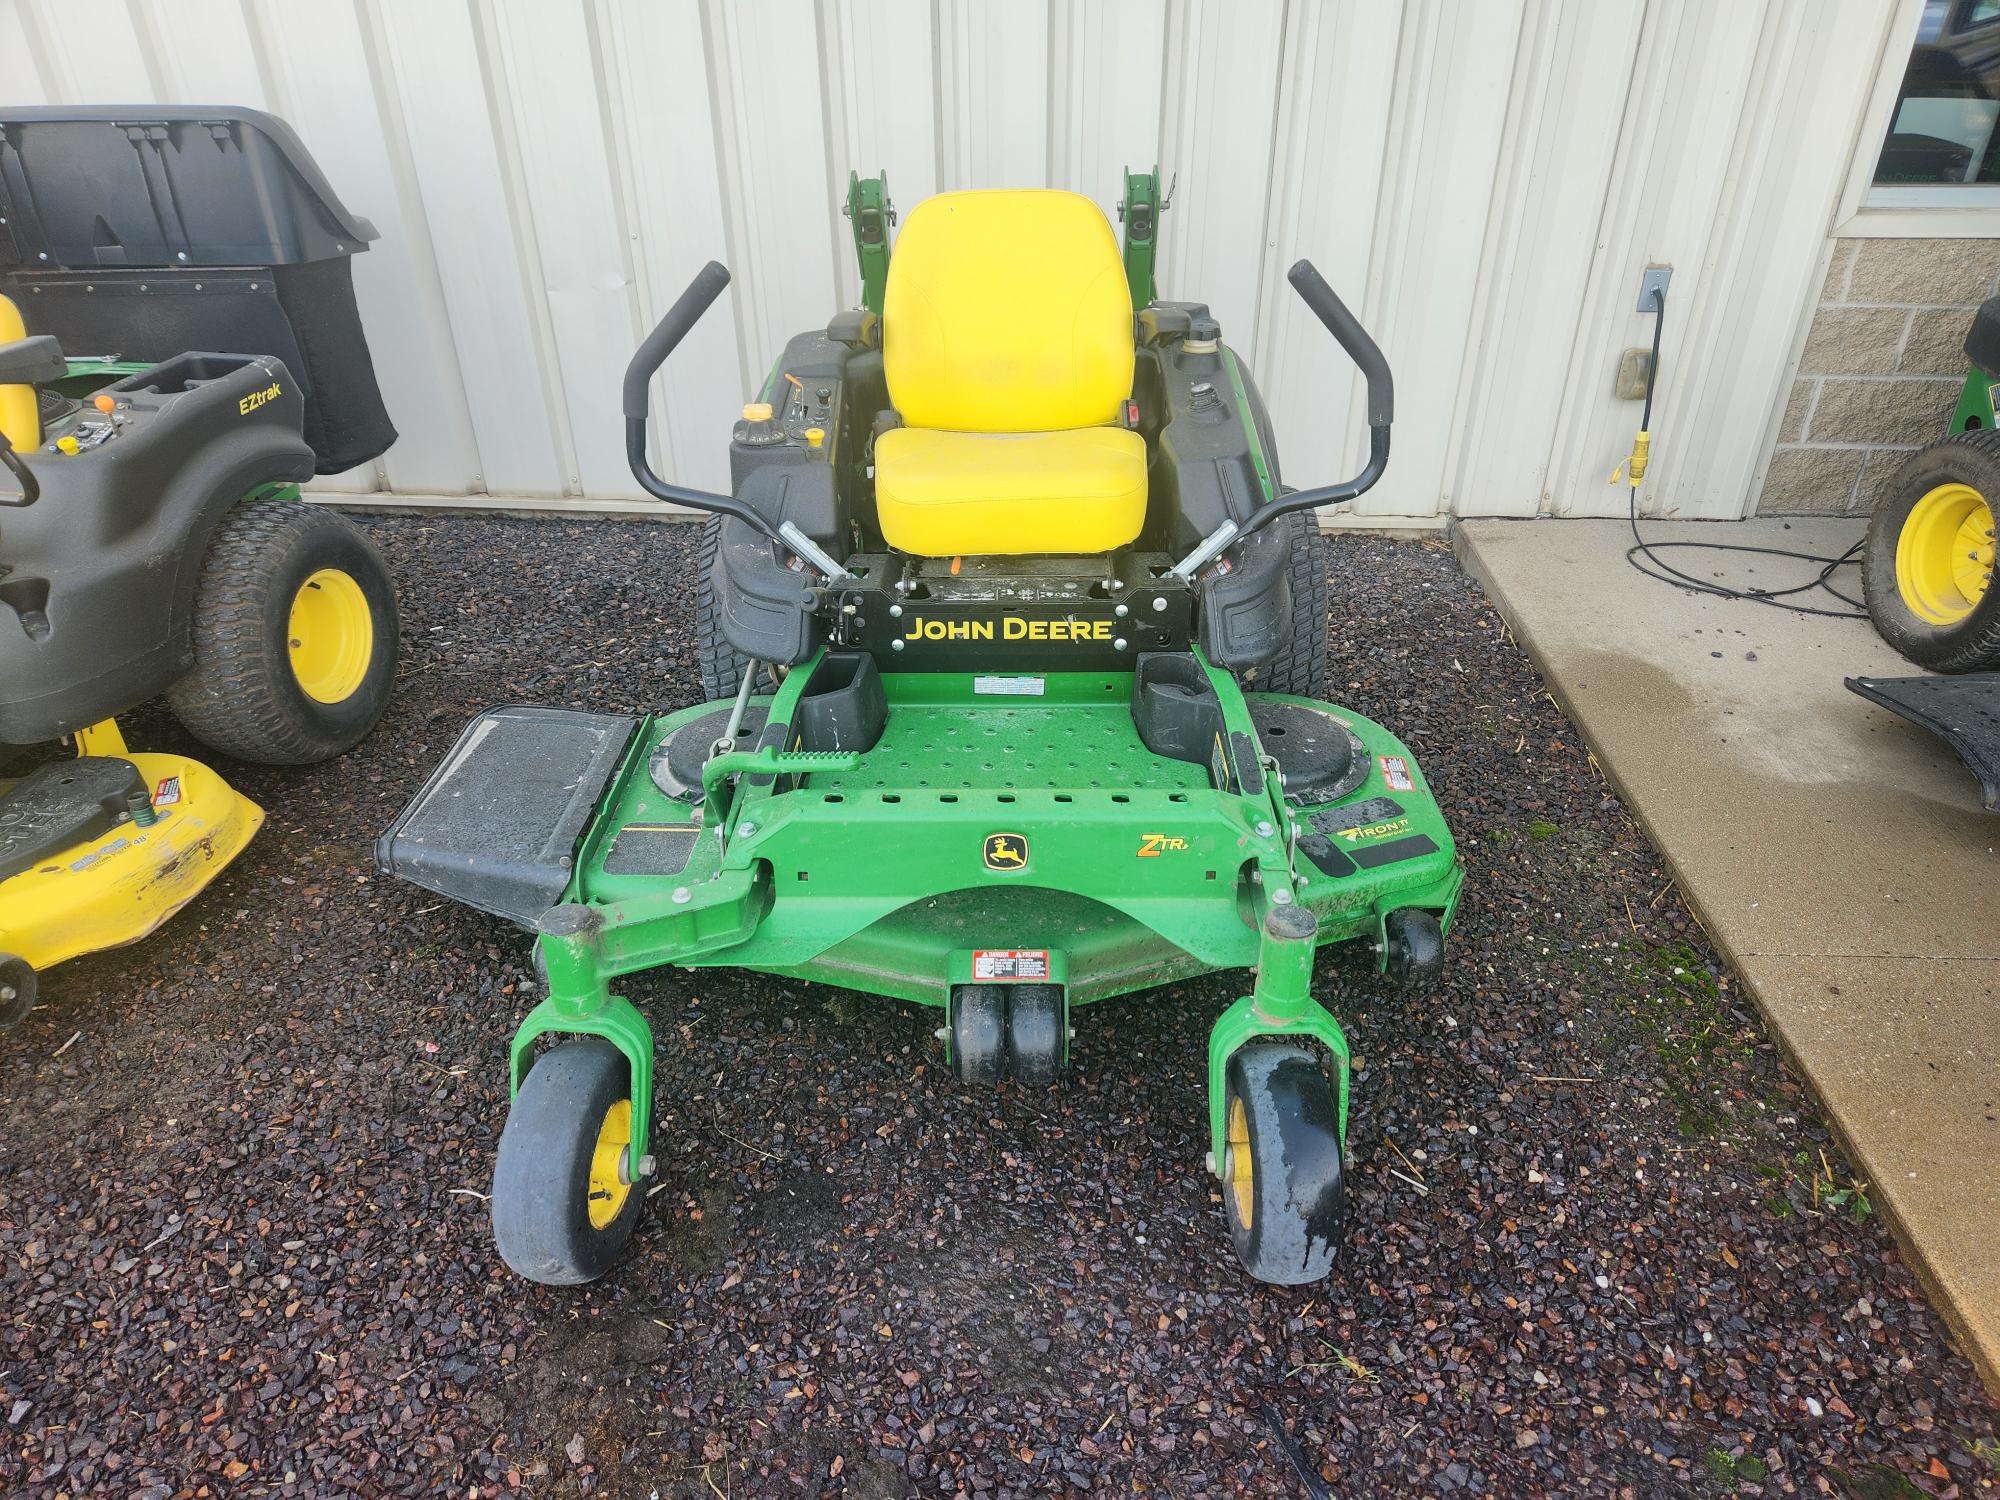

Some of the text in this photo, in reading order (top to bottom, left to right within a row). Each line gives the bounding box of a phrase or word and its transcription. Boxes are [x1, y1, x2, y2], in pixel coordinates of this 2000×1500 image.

[239, 382, 281, 415] EZtrak
[905, 617, 1113, 640] JOHN DEERE
